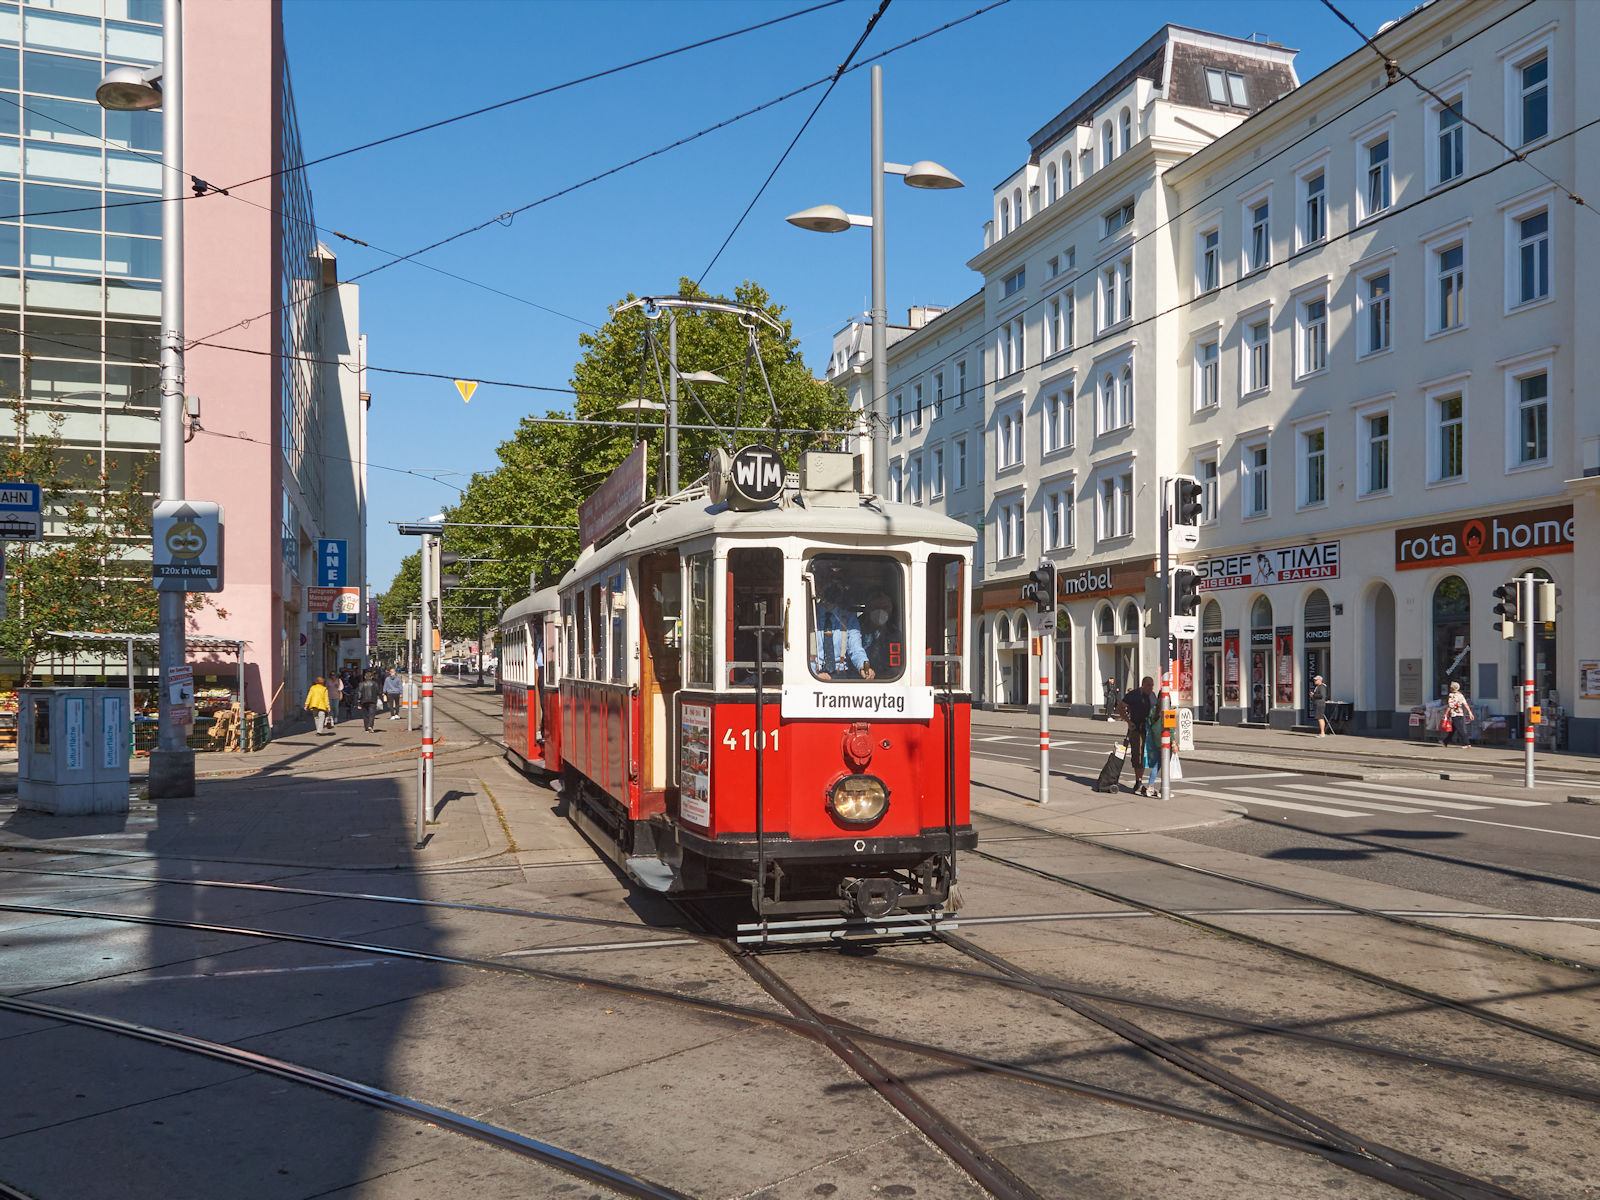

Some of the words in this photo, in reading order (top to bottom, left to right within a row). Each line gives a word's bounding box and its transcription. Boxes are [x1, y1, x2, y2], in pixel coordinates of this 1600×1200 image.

[736, 450, 782, 492] WTM
[1400, 533, 1457, 561] rota
[160, 567, 180, 575] 120x
[181, 567, 189, 575] in
[191, 567, 211, 575] Wien
[1195, 555, 1252, 579] SREF
[1277, 544, 1338, 570] TIME
[1065, 567, 1113, 594] möbel
[1198, 576, 1243, 589] RISEUR
[1282, 567, 1332, 580] SALON
[813, 691, 905, 713] Tramwaytag
[722, 727, 779, 752] 4101
